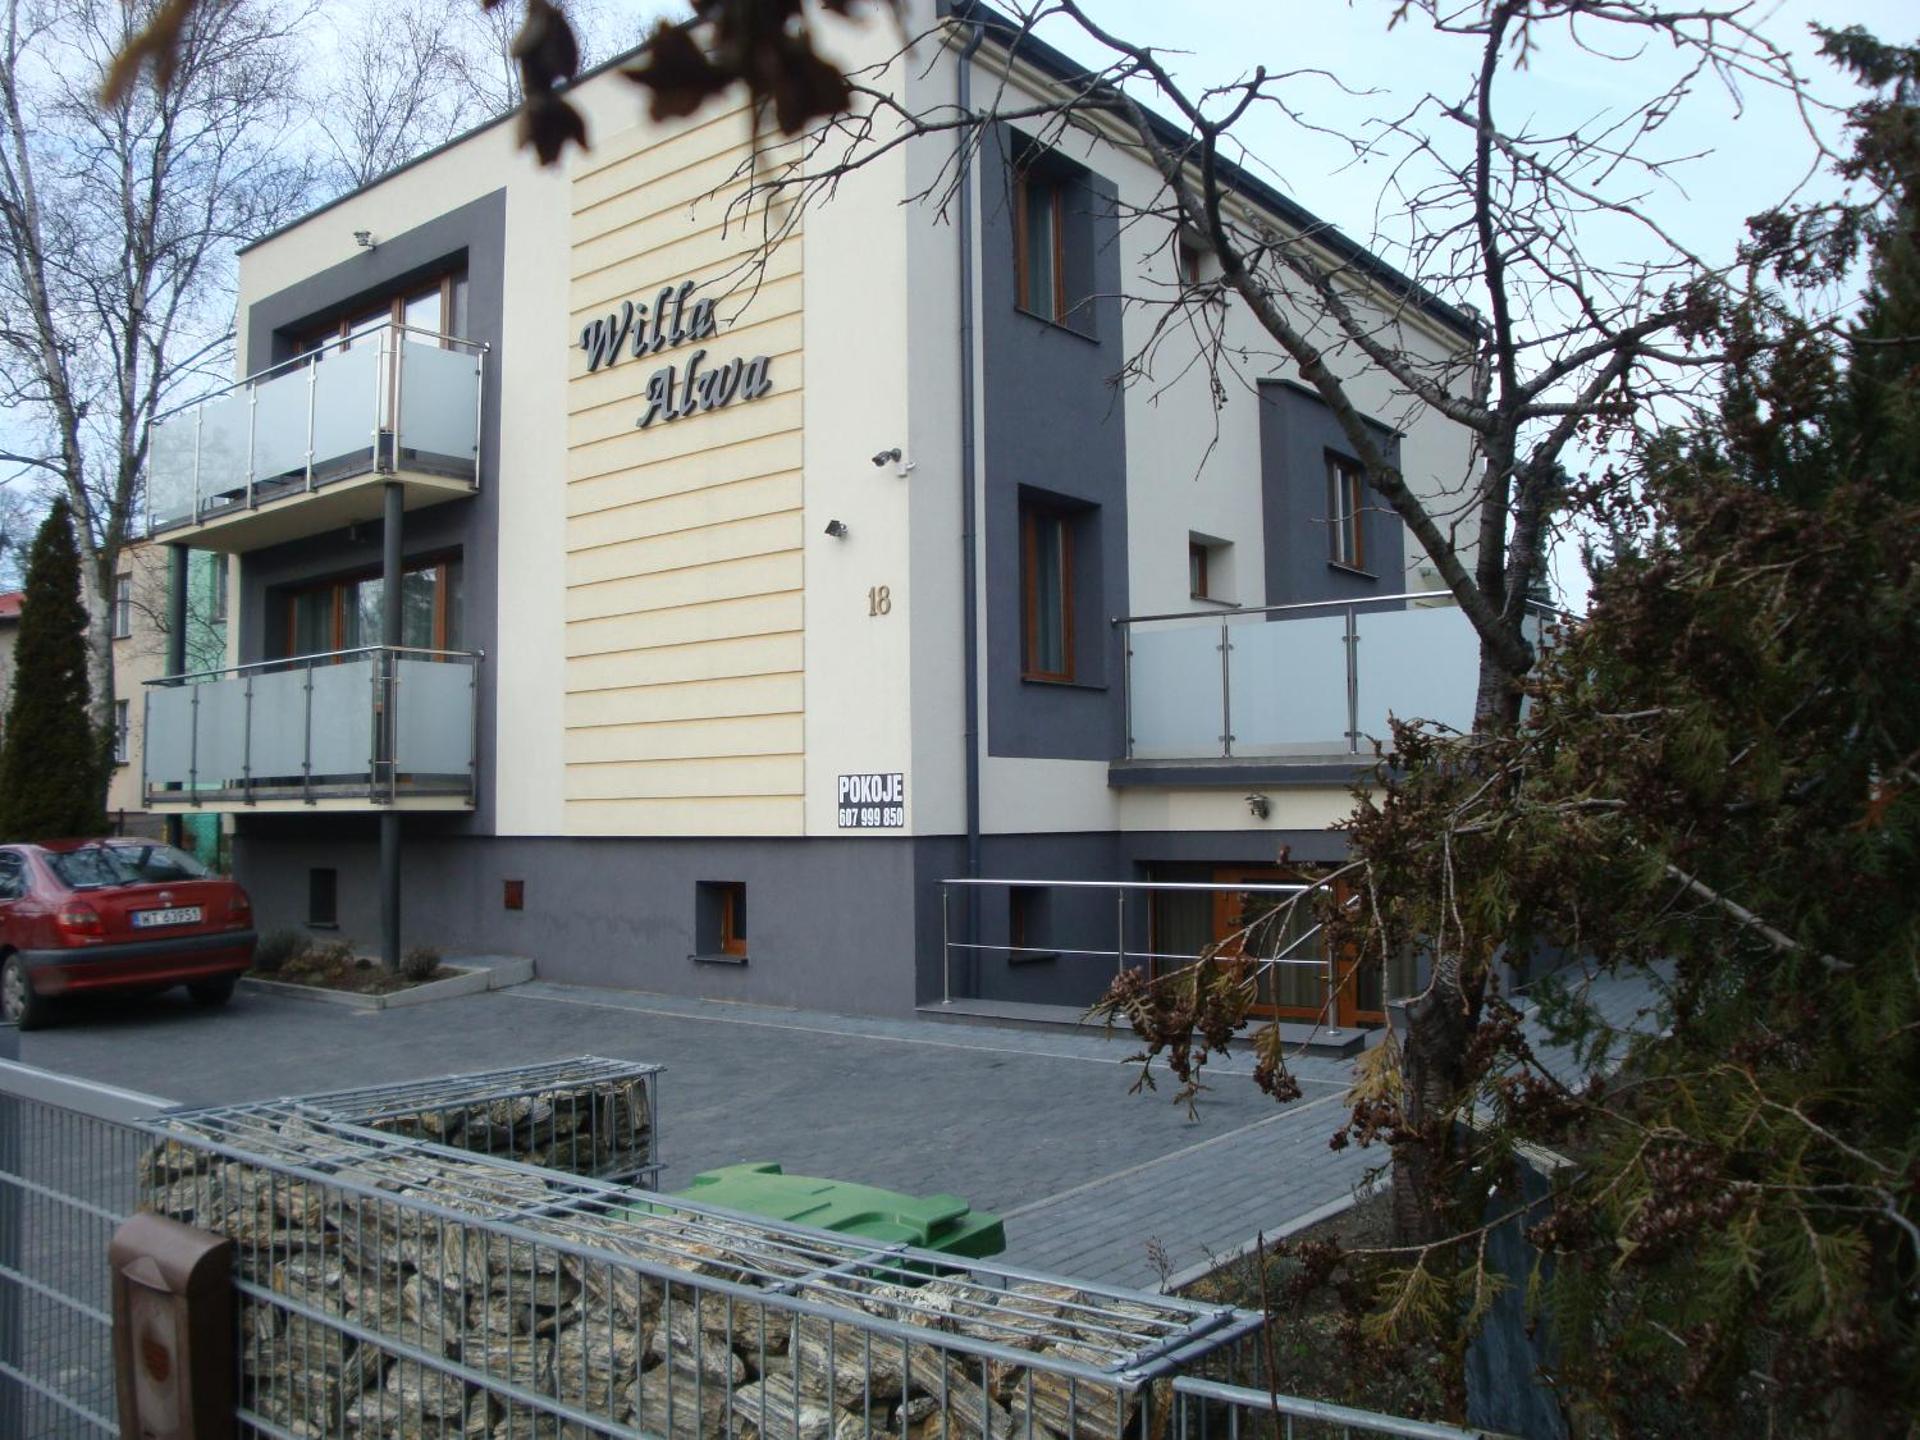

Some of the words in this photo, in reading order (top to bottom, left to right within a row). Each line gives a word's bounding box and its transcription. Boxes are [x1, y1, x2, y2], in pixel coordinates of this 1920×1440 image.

[579, 279, 715, 372] Willa
[635, 349, 773, 428] Alwa
[868, 585, 892, 617] 18
[839, 774, 903, 803] POKOJE
[839, 808, 859, 826] 607
[861, 807, 881, 826] 999
[883, 807, 903, 826] 850
